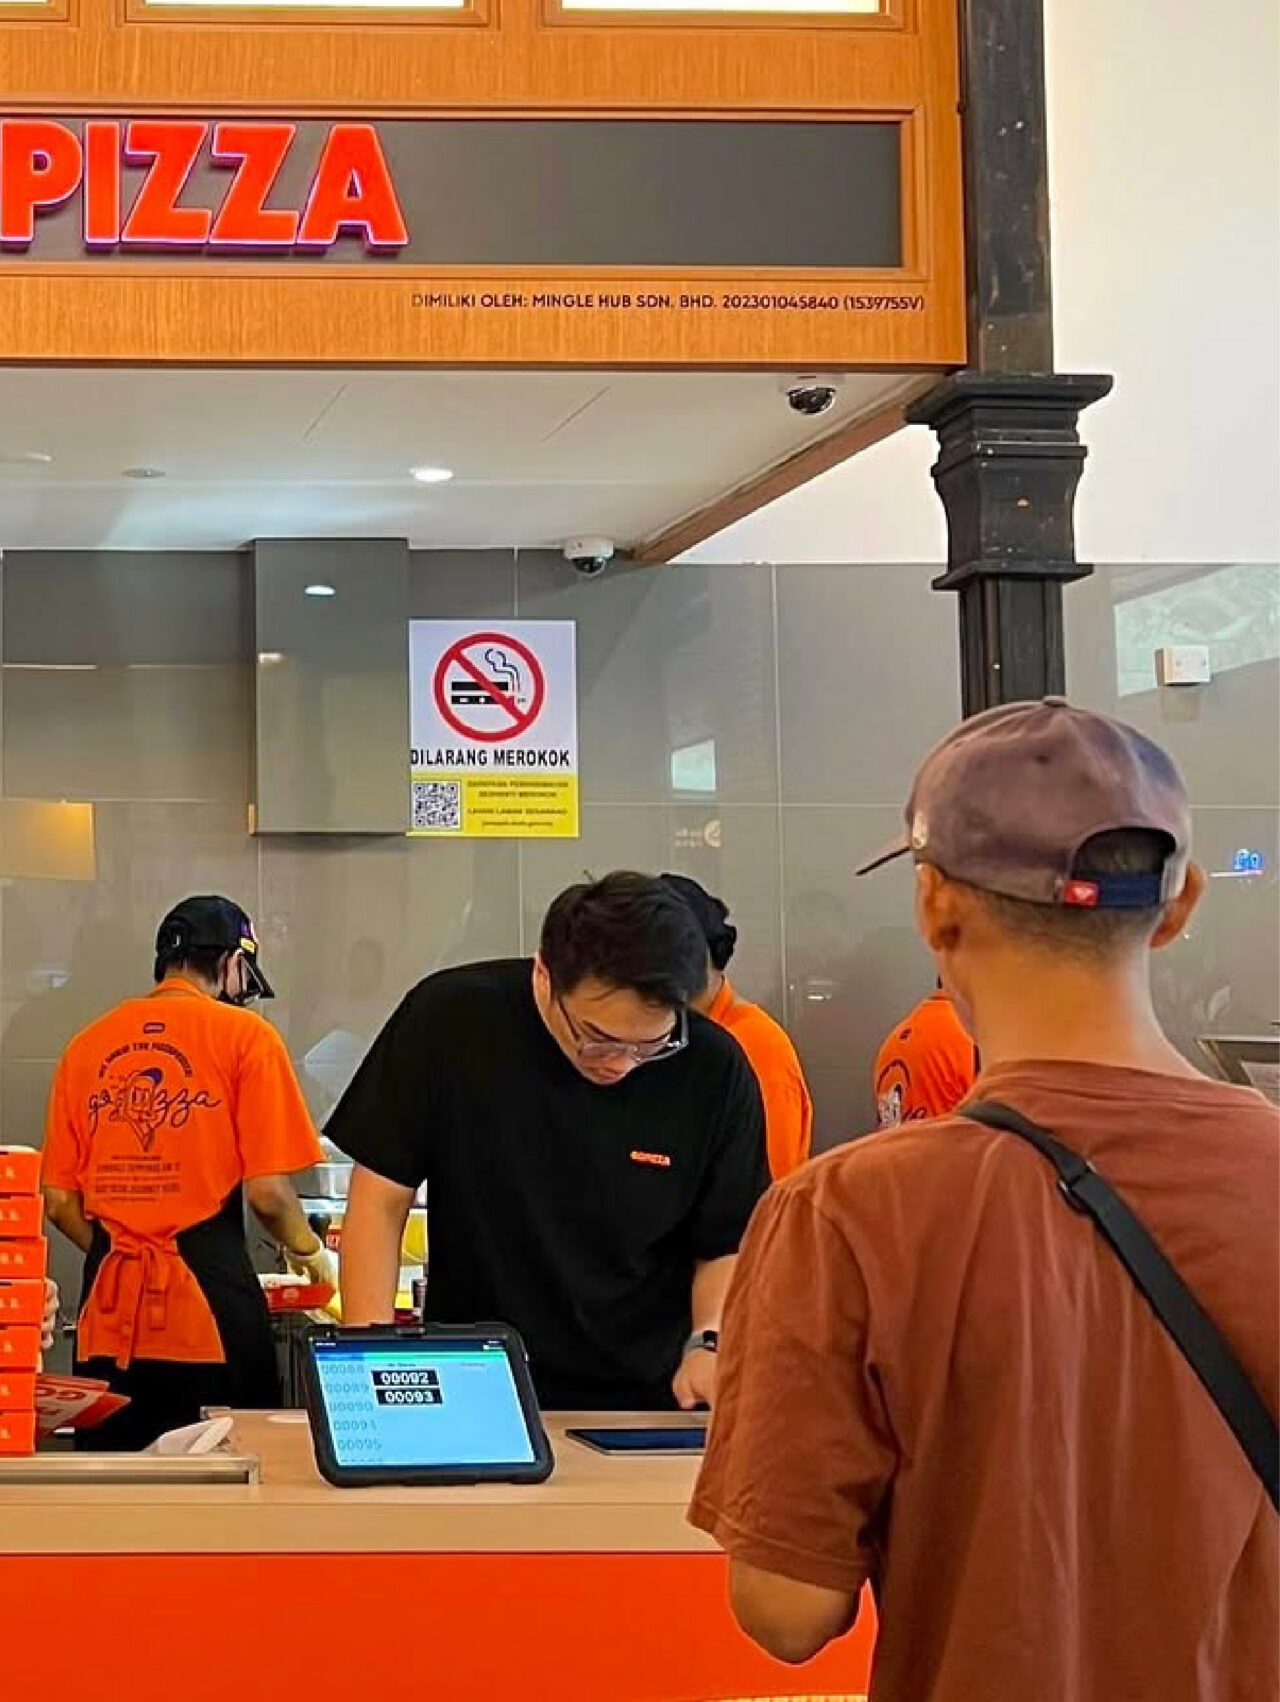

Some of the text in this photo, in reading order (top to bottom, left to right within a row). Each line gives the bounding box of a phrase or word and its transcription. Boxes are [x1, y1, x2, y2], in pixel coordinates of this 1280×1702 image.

[411, 294, 926, 310] DIMILIKI OLEH: MINGLE HUB SDN. BHD. 202301045840 (1539755V)
[411, 749, 570, 767] DILARANG MEROKOK
